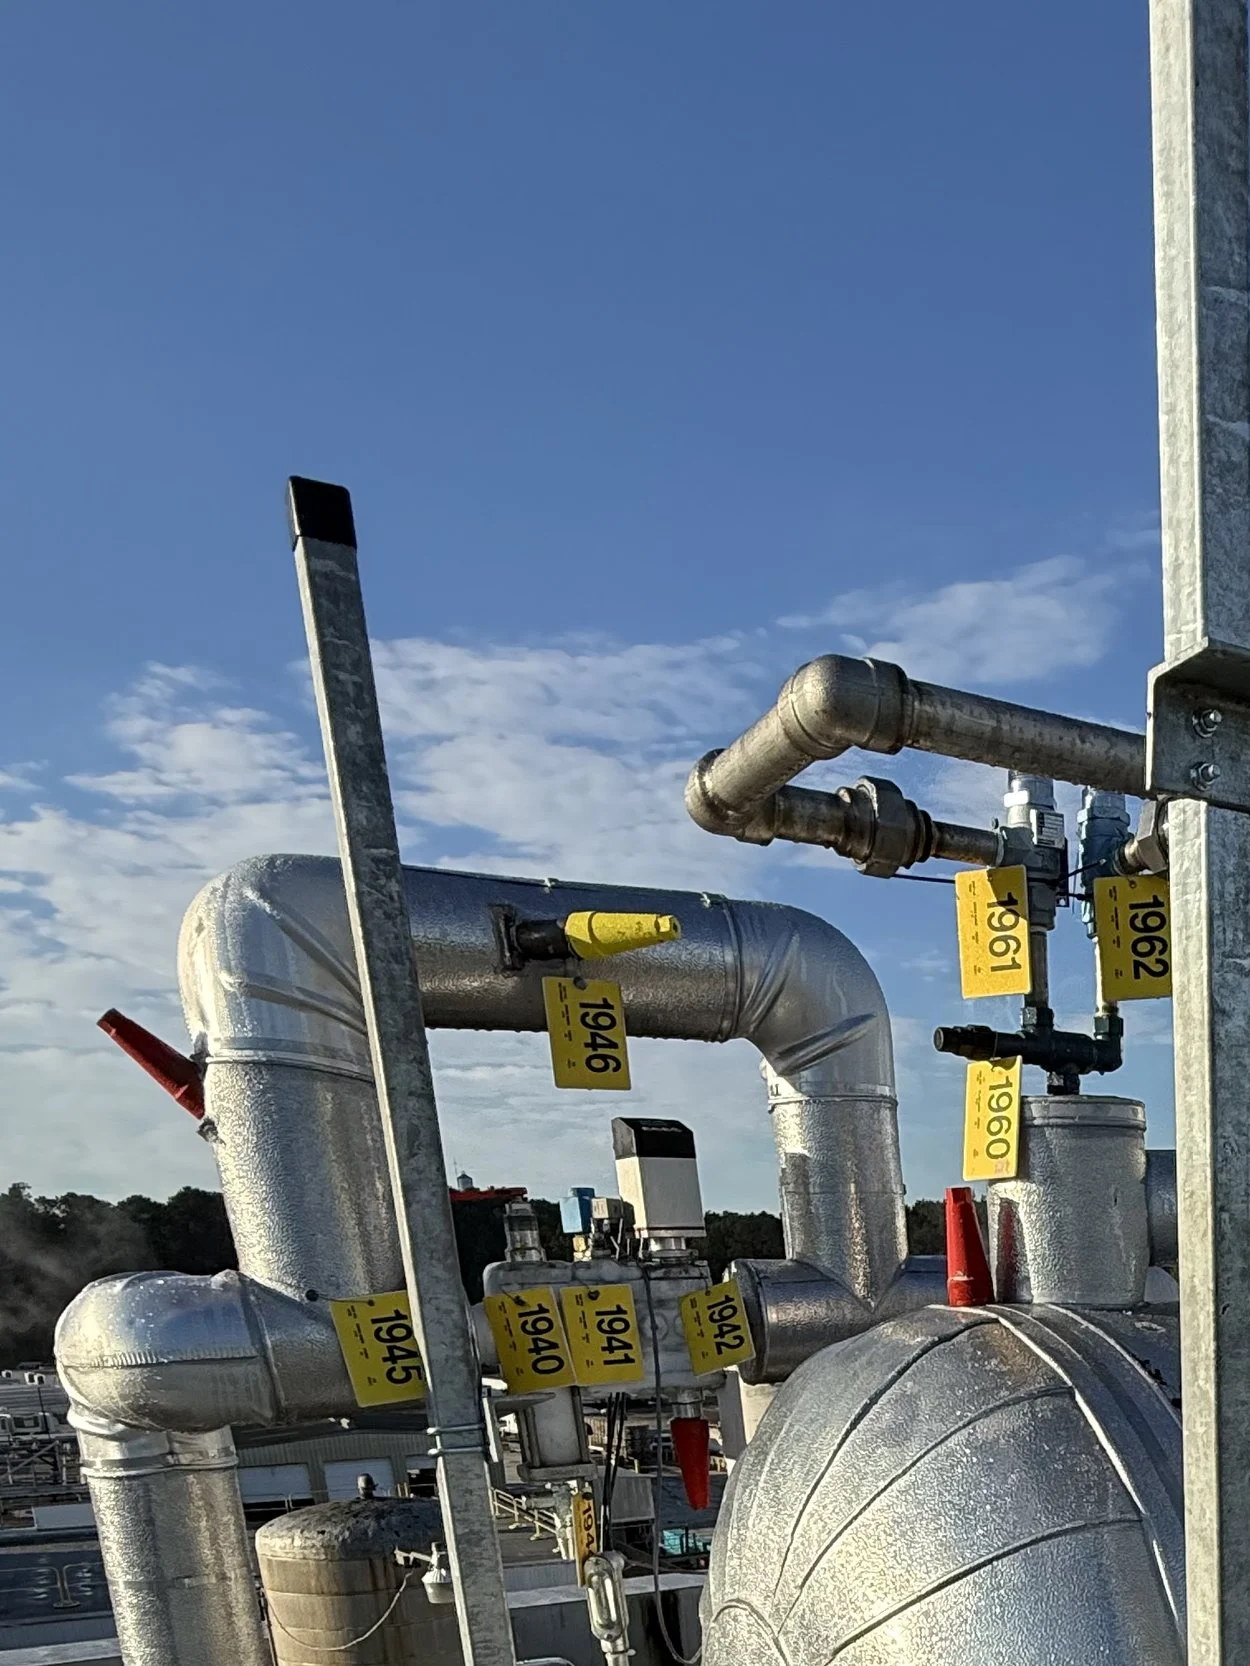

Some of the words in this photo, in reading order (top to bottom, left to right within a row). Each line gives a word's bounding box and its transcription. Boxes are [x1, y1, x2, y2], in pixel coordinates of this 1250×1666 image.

[986, 891, 1022, 973] 1961
[1129, 894, 1169, 980] 1962
[579, 997, 622, 1073] 1946
[985, 1075, 1013, 1160] 1960
[370, 1308, 423, 1385] 1945
[517, 1303, 565, 1375] 1940
[594, 1303, 636, 1366] 1941
[707, 1294, 745, 1356] 1942
